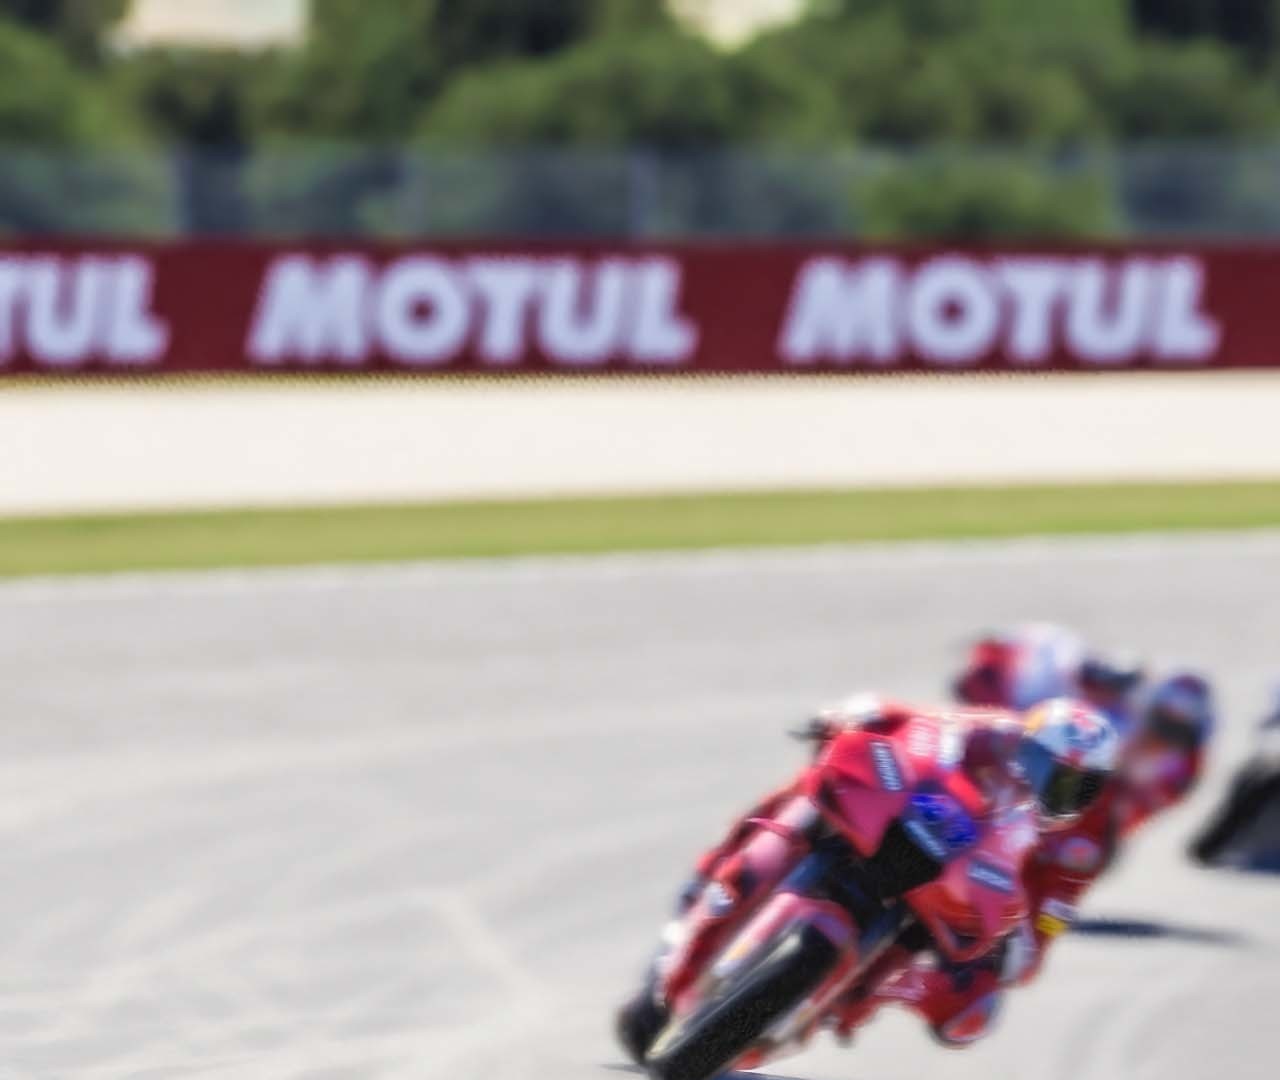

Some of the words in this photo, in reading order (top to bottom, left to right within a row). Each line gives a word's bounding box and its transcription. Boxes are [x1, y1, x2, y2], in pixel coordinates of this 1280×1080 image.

[0, 258, 165, 361] UL
[252, 258, 693, 361] MOTUL
[782, 258, 1215, 360] MOTUL
